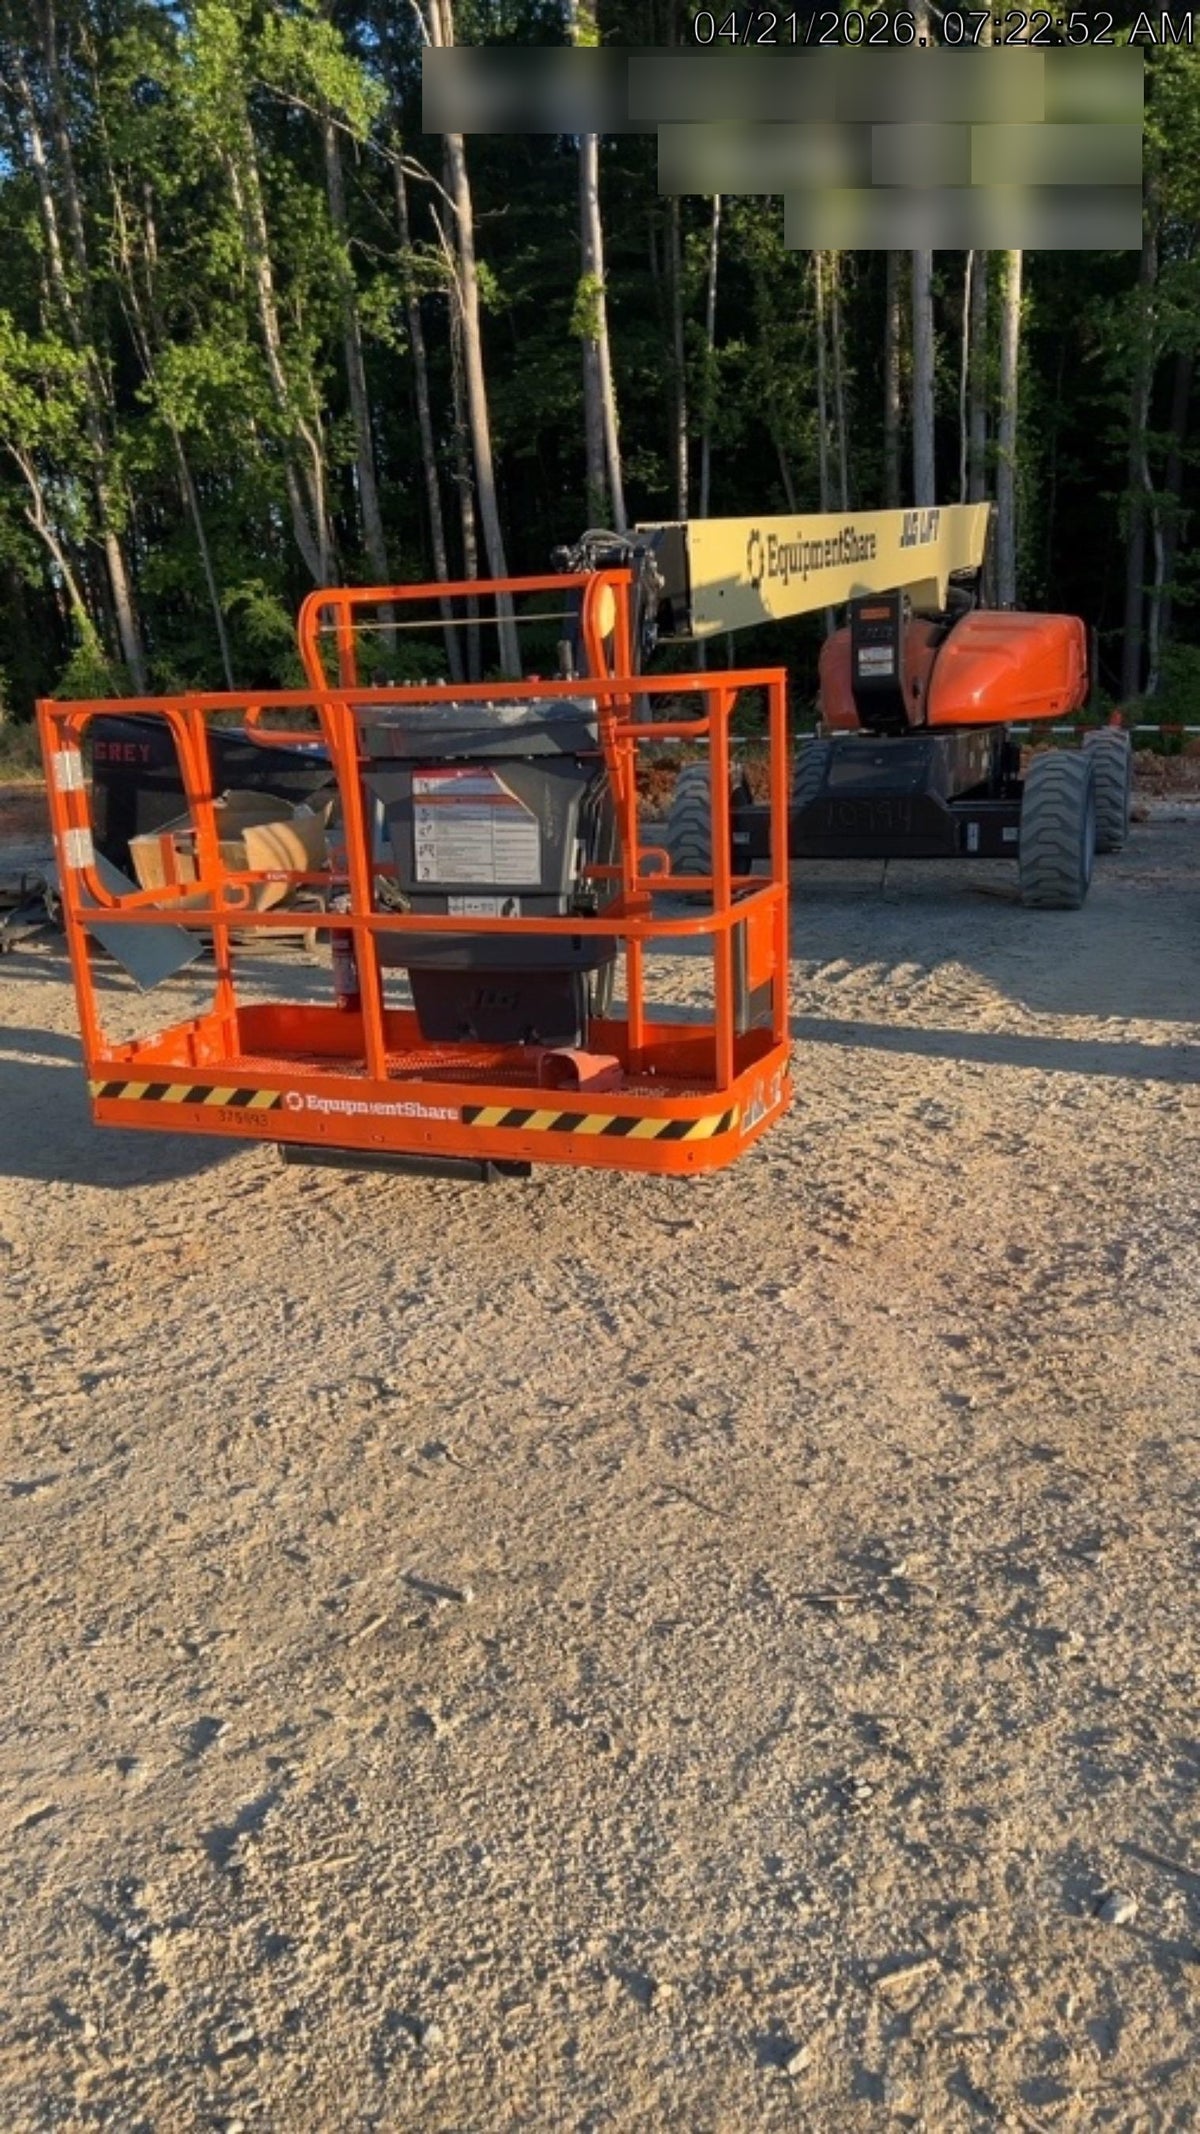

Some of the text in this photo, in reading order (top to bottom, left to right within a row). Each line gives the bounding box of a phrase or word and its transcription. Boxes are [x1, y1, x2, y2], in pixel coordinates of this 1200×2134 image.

[900, 508, 940, 549] JLG LIFT
[767, 526, 876, 586] EquipmentShare
[94, 741, 151, 763] GREY
[306, 1095, 459, 1120] EquipmentShare
